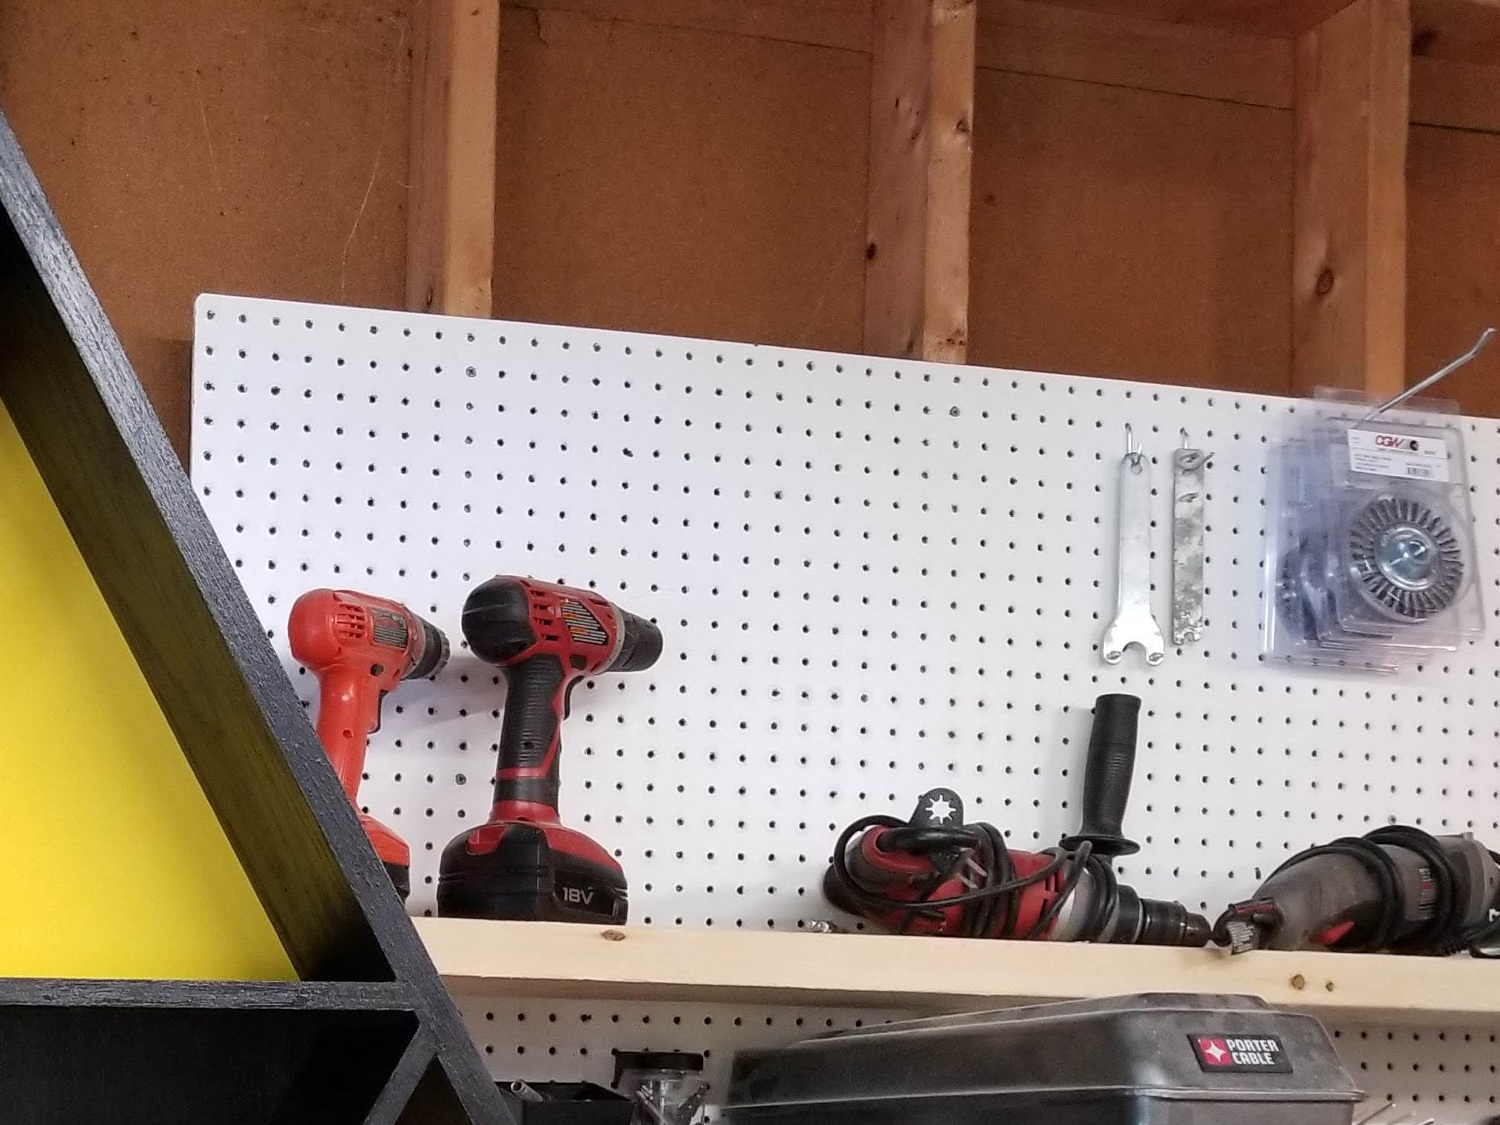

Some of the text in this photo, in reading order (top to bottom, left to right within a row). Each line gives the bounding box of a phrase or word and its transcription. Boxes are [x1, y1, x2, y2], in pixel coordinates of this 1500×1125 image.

[563, 887, 594, 905] 18V
[1225, 1039, 1280, 1052] PORTER
[1231, 1052, 1275, 1065] CABLE
